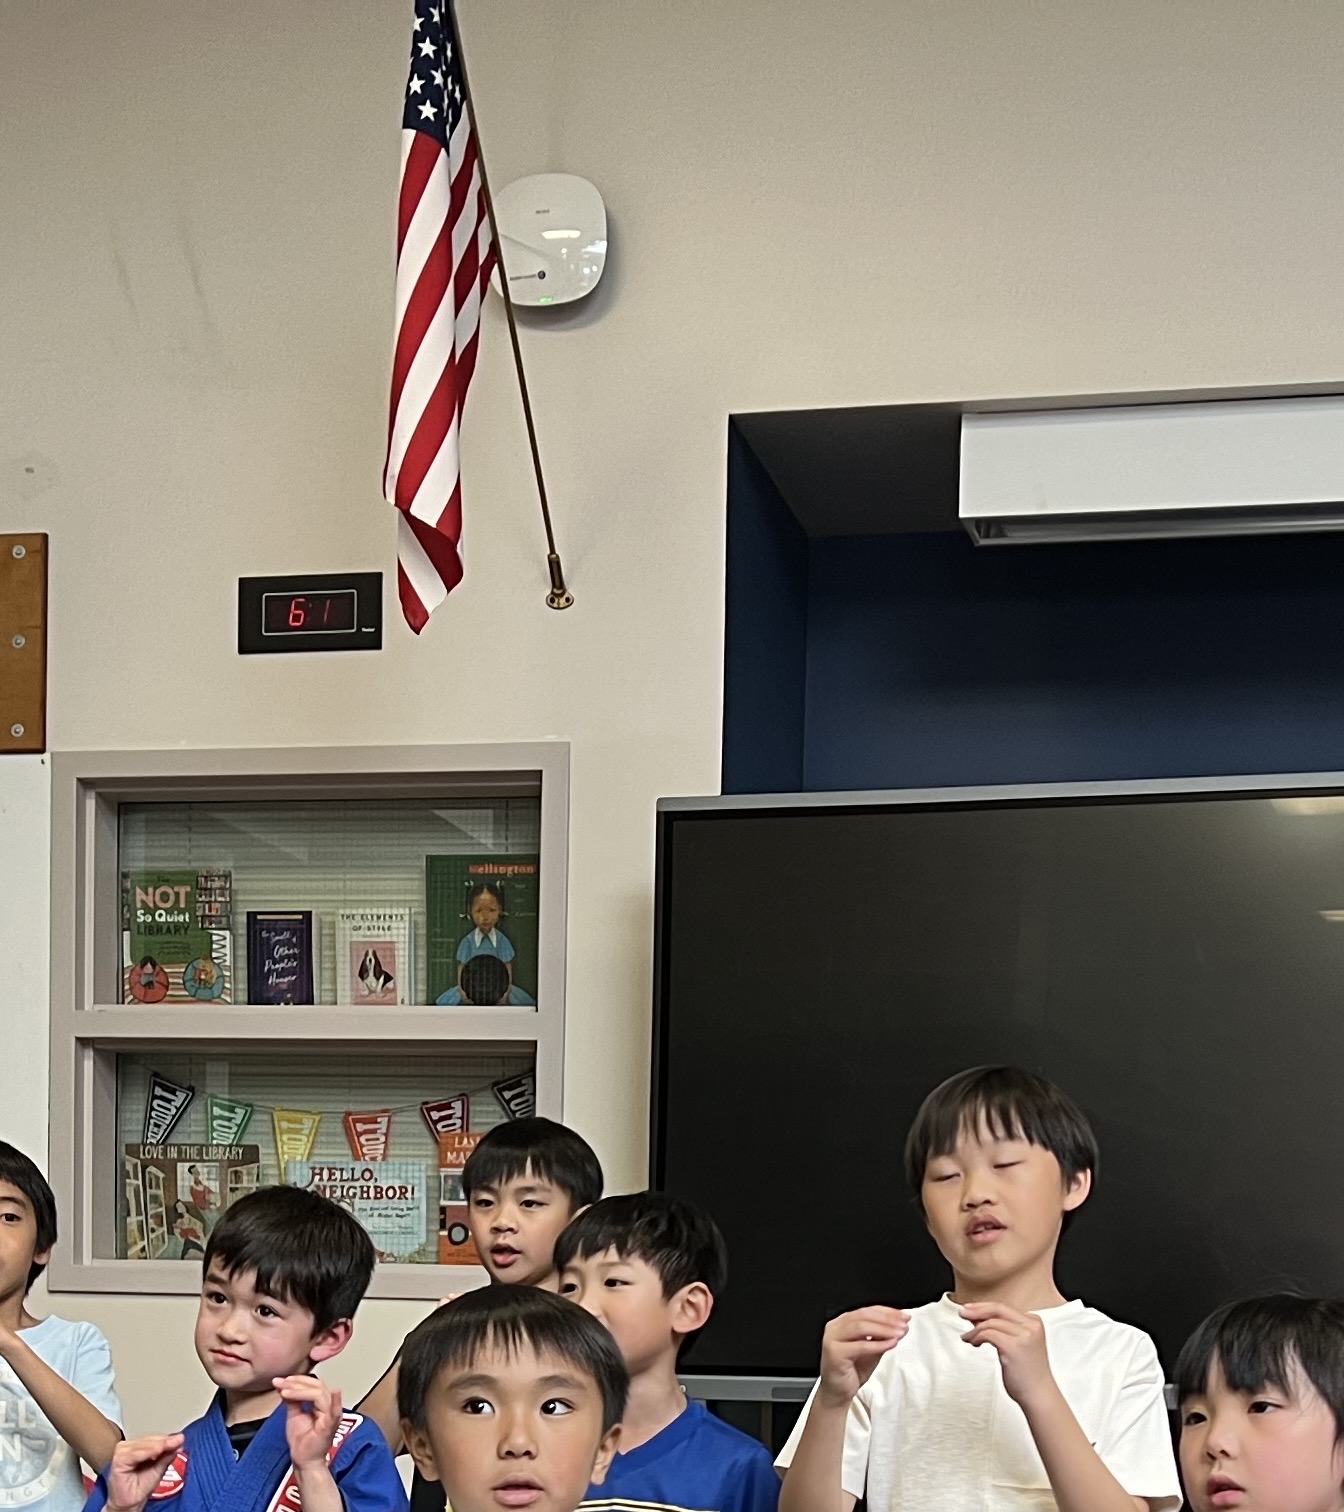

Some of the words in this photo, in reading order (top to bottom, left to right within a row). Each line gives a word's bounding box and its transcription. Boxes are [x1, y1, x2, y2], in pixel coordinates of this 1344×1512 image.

[135, 885, 191, 909] NOT
[136, 909, 152, 923] So
[155, 909, 190, 923] Quiet
[136, 922, 191, 937] LIBRARY
[139, 1145, 163, 1159] LOVE
[167, 1146, 178, 1159] IN
[181, 1146, 199, 1159] THE
[202, 1146, 244, 1160] LIBRARY
[308, 1166, 378, 1184] HELLO,
[315, 1184, 415, 1201] NEIGHBOR!
